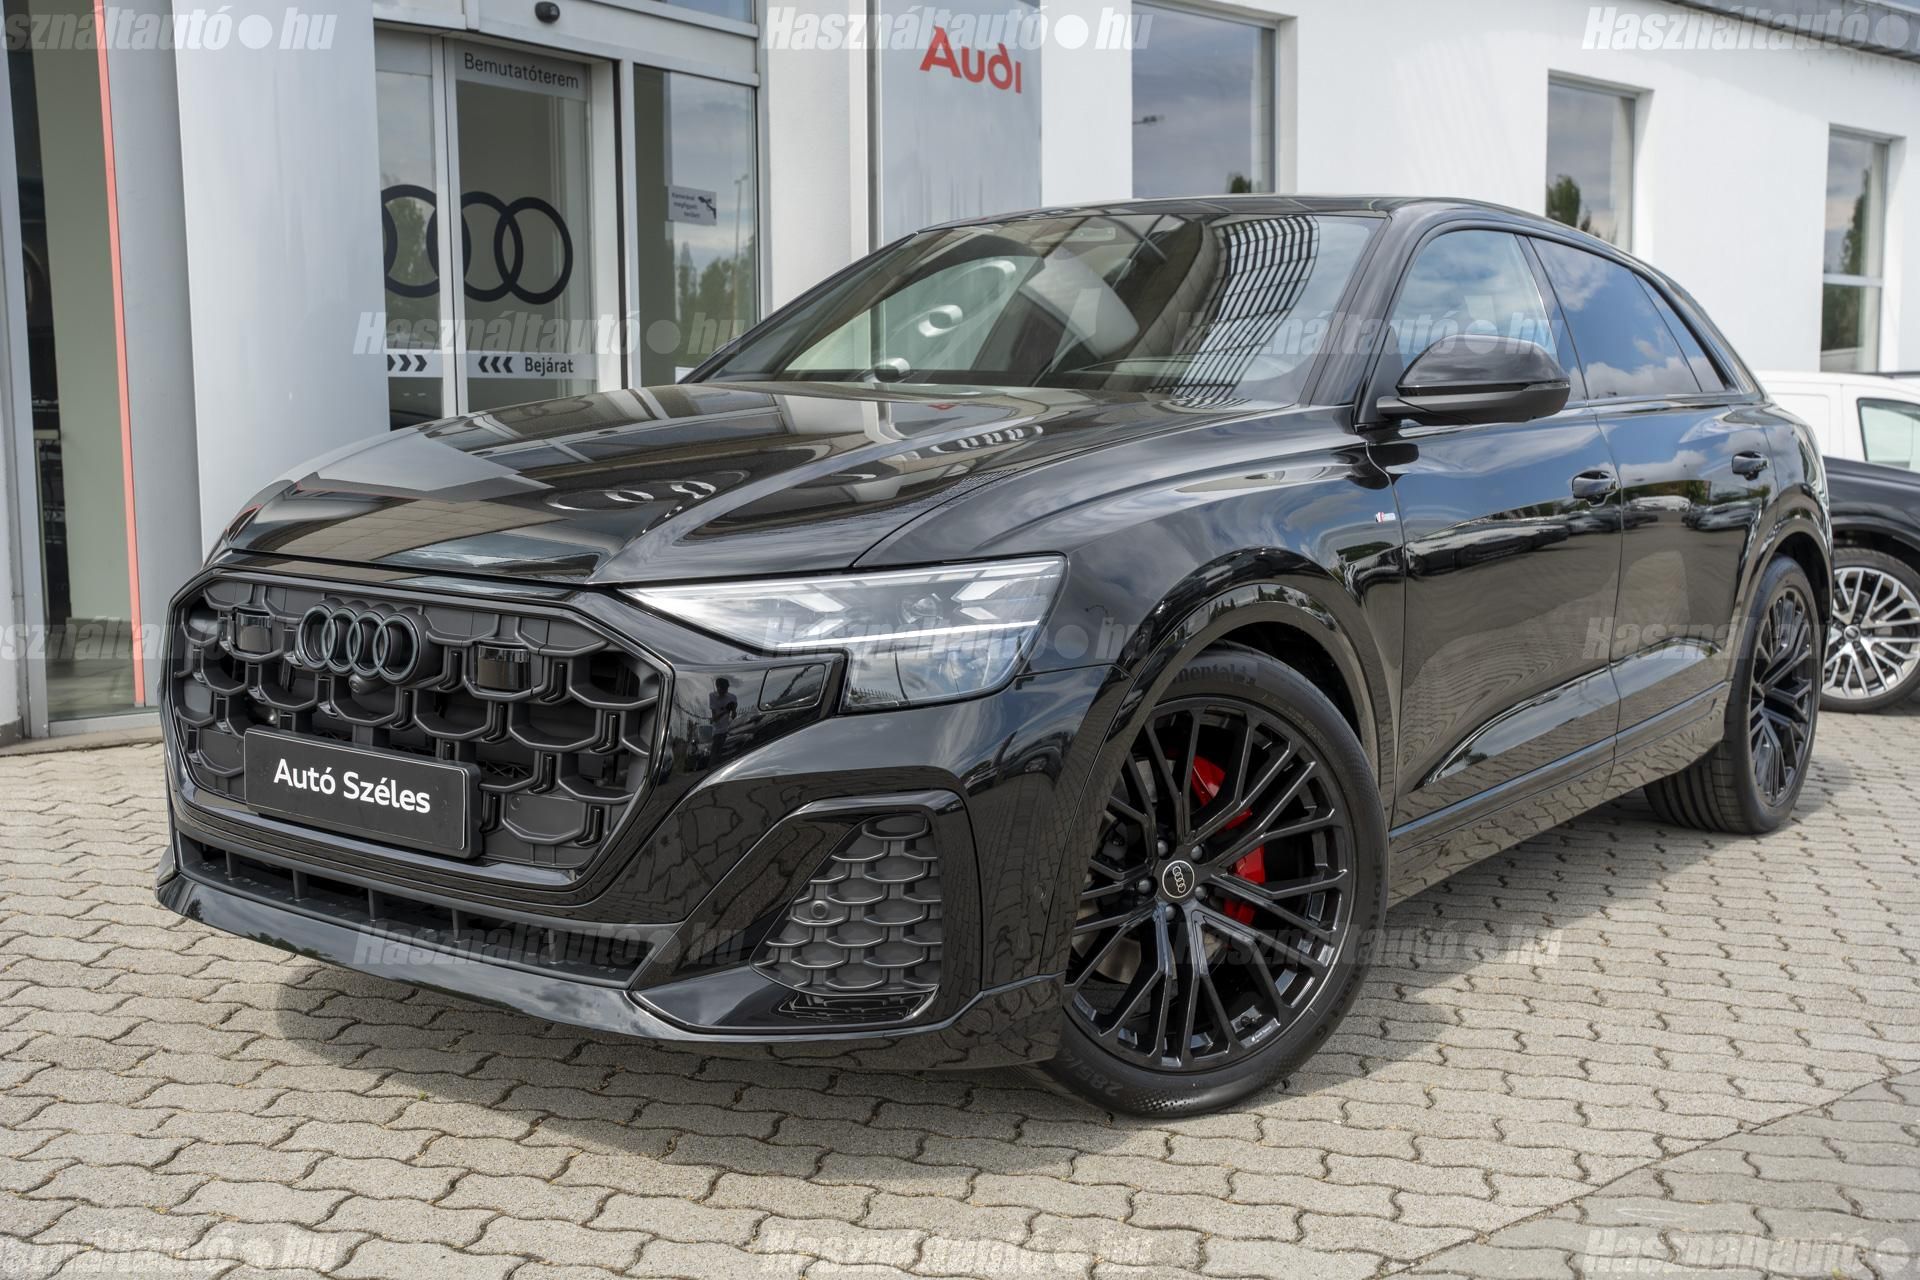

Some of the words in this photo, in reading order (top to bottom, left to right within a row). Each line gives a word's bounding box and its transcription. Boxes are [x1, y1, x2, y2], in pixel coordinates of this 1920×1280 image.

[464, 52, 579, 89] Bemutatóterem
[920, 25, 1022, 94] Audi
[525, 357, 574, 377] Bejárat
[273, 758, 336, 795] Autó
[343, 771, 431, 814] Széles
